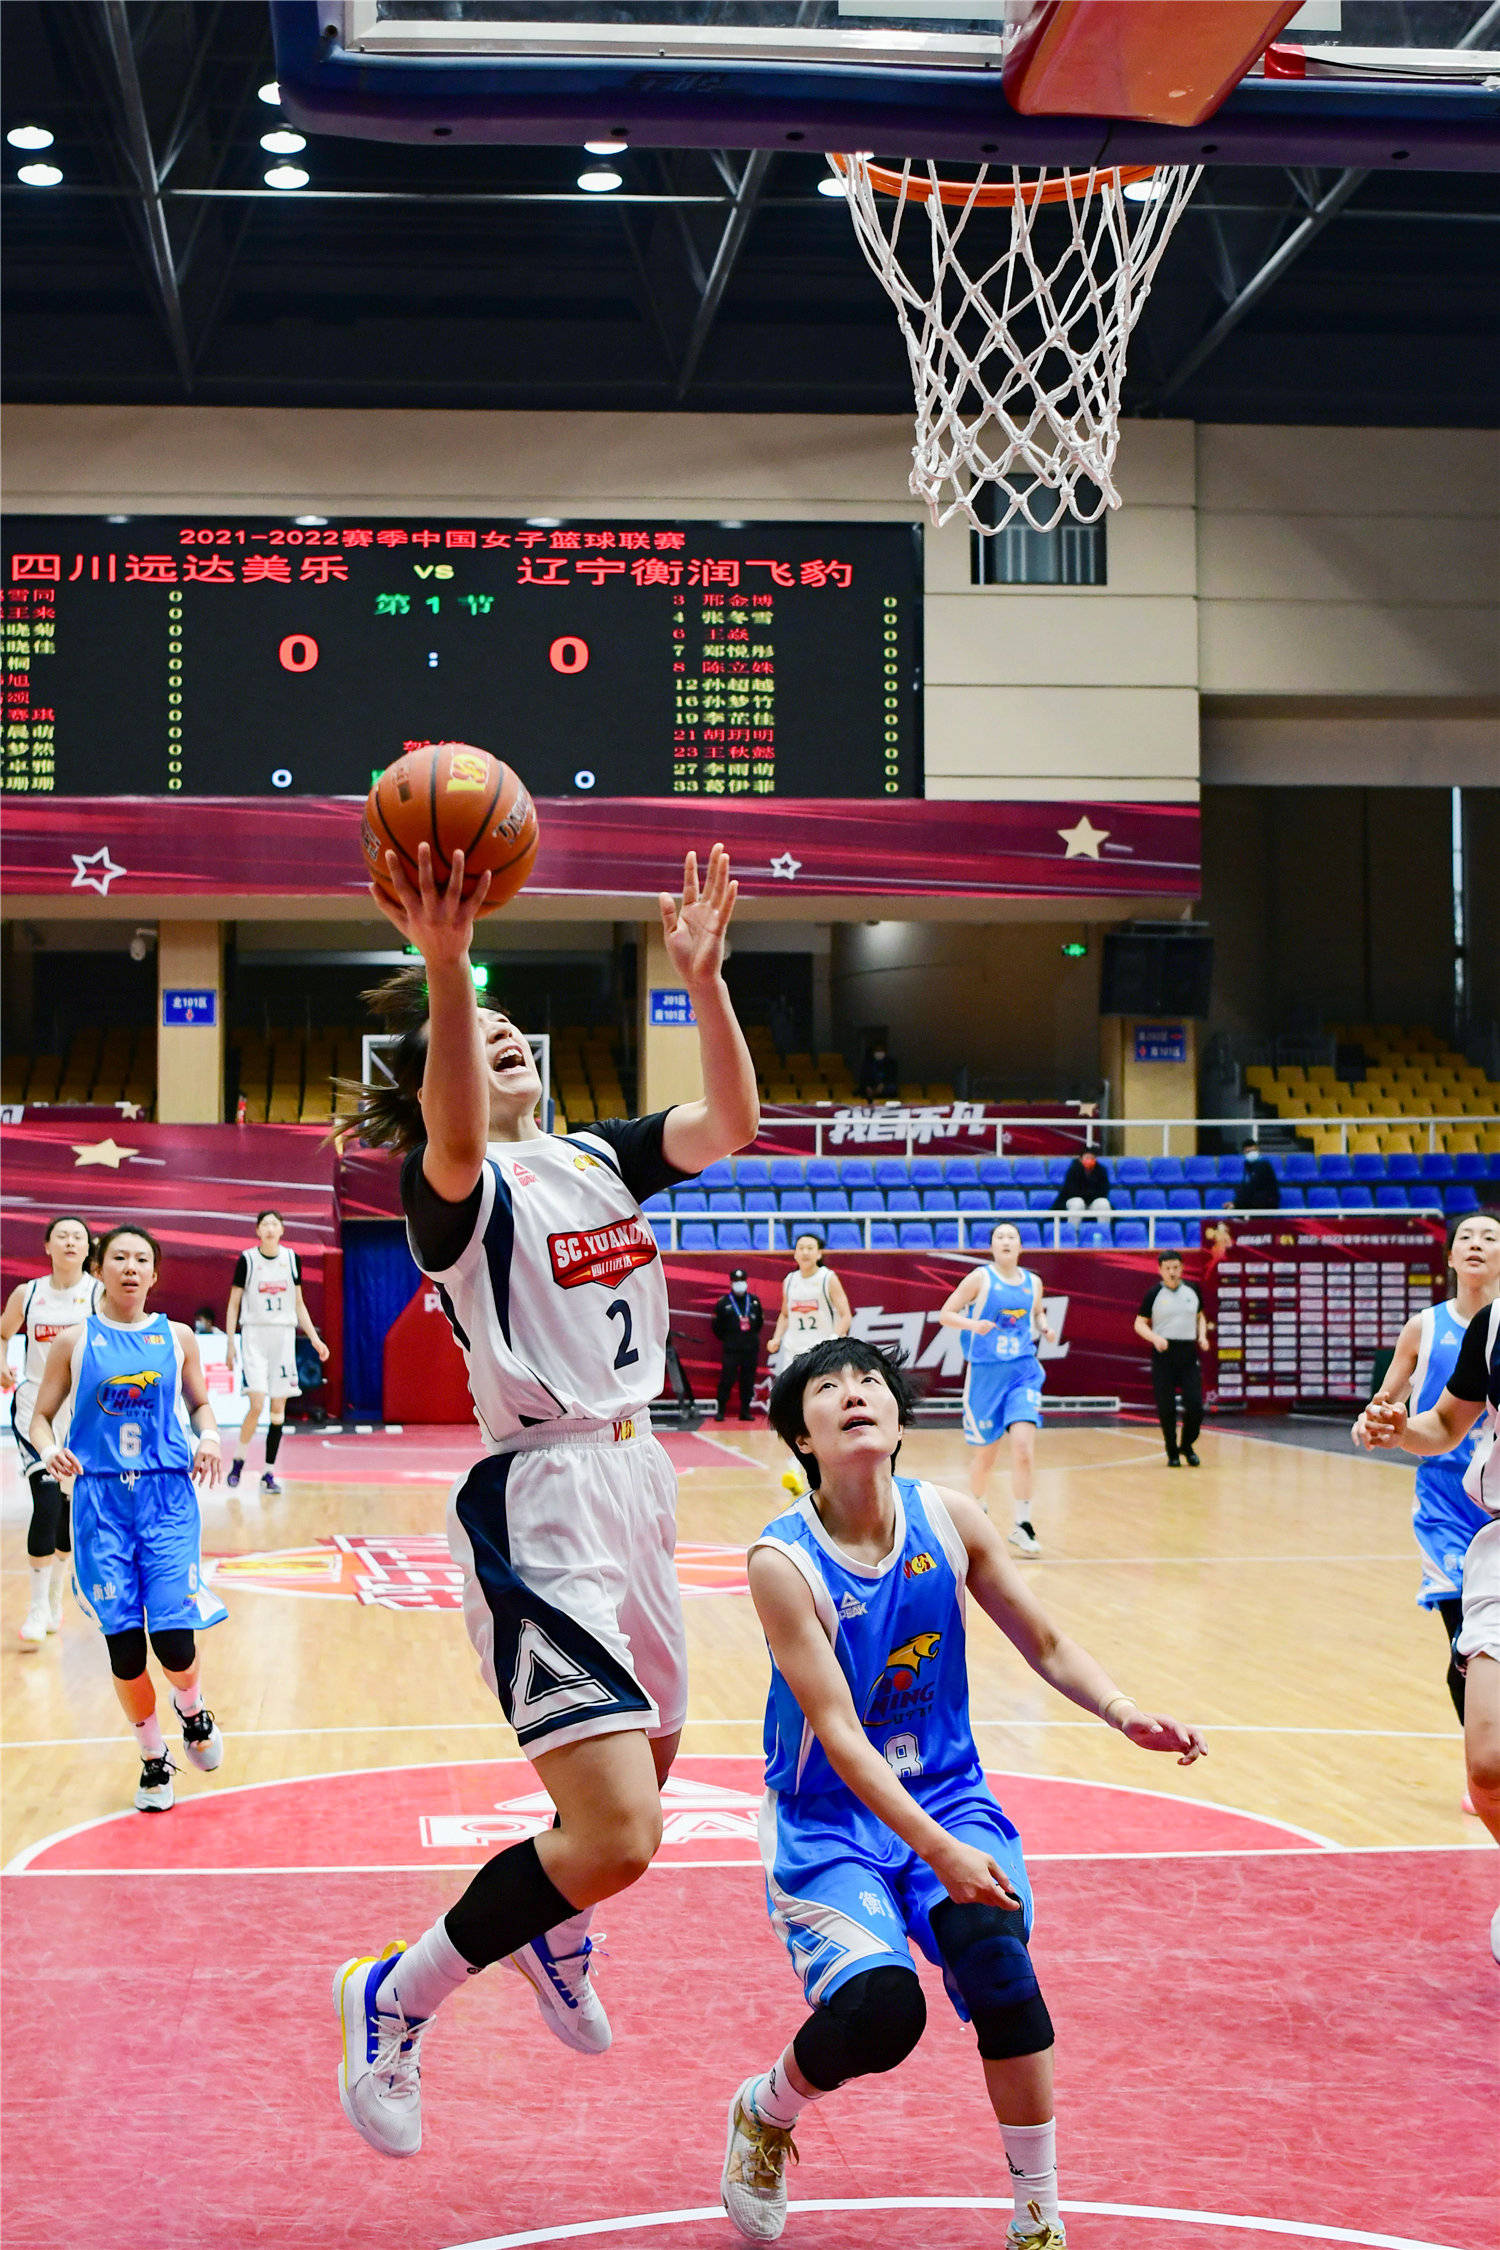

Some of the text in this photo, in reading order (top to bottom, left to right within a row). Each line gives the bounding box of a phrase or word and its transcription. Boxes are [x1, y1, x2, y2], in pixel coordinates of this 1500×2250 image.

[179, 529, 685, 549] 2021-2022赛季中国女子篮球联赛
[12, 554, 348, 584] 四川远达美乐
[517, 557, 852, 587] 辽宁衡润飞豹
[0, 589, 182, 602] 雪同 0
[674, 595, 685, 605] 3
[884, 598, 897, 607] 0
[0, 606, 182, 619] 王来 0
[674, 612, 684, 623] 4
[884, 614, 897, 624] 0
[169, 625, 182, 636] 0
[673, 629, 685, 639] 6
[884, 631, 897, 641] 0
[0, 640, 182, 654] 晓佳 0
[673, 645, 684, 656] 7
[884, 648, 897, 657] 0
[279, 634, 319, 672] 0
[549, 636, 589, 674] 0
[169, 659, 182, 669] 0
[673, 662, 685, 672] 8
[884, 664, 897, 674] 0
[0, 674, 182, 687] 旭 0
[676, 679, 697, 690] 12
[884, 681, 897, 691] 0
[0, 691, 182, 704] 颂 0
[676, 696, 698, 707] 16
[885, 698, 898, 708] 0
[0, 708, 182, 721] 赛琪 0
[676, 713, 698, 724] 19
[885, 715, 898, 725] 0
[169, 727, 182, 738] 0
[674, 730, 695, 740] 21
[885, 732, 898, 741] 0
[169, 744, 182, 755] 0
[674, 747, 698, 757] 23
[885, 749, 898, 759] 0
[169, 762, 182, 772] 0
[674, 763, 697, 775] 27
[885, 765, 898, 775] 0
[0, 776, 182, 790] 珊珊 0
[272, 769, 595, 789] 0 0
[674, 781, 698, 791] 33
[885, 782, 898, 792] 0
[265, 1297, 282, 1311] 11
[798, 1316, 818, 1331] 12
[606, 1299, 639, 1370] 2
[995, 1335, 1019, 1354] 23
[120, 1422, 142, 1457] 6
[884, 1732, 924, 1777] 8
